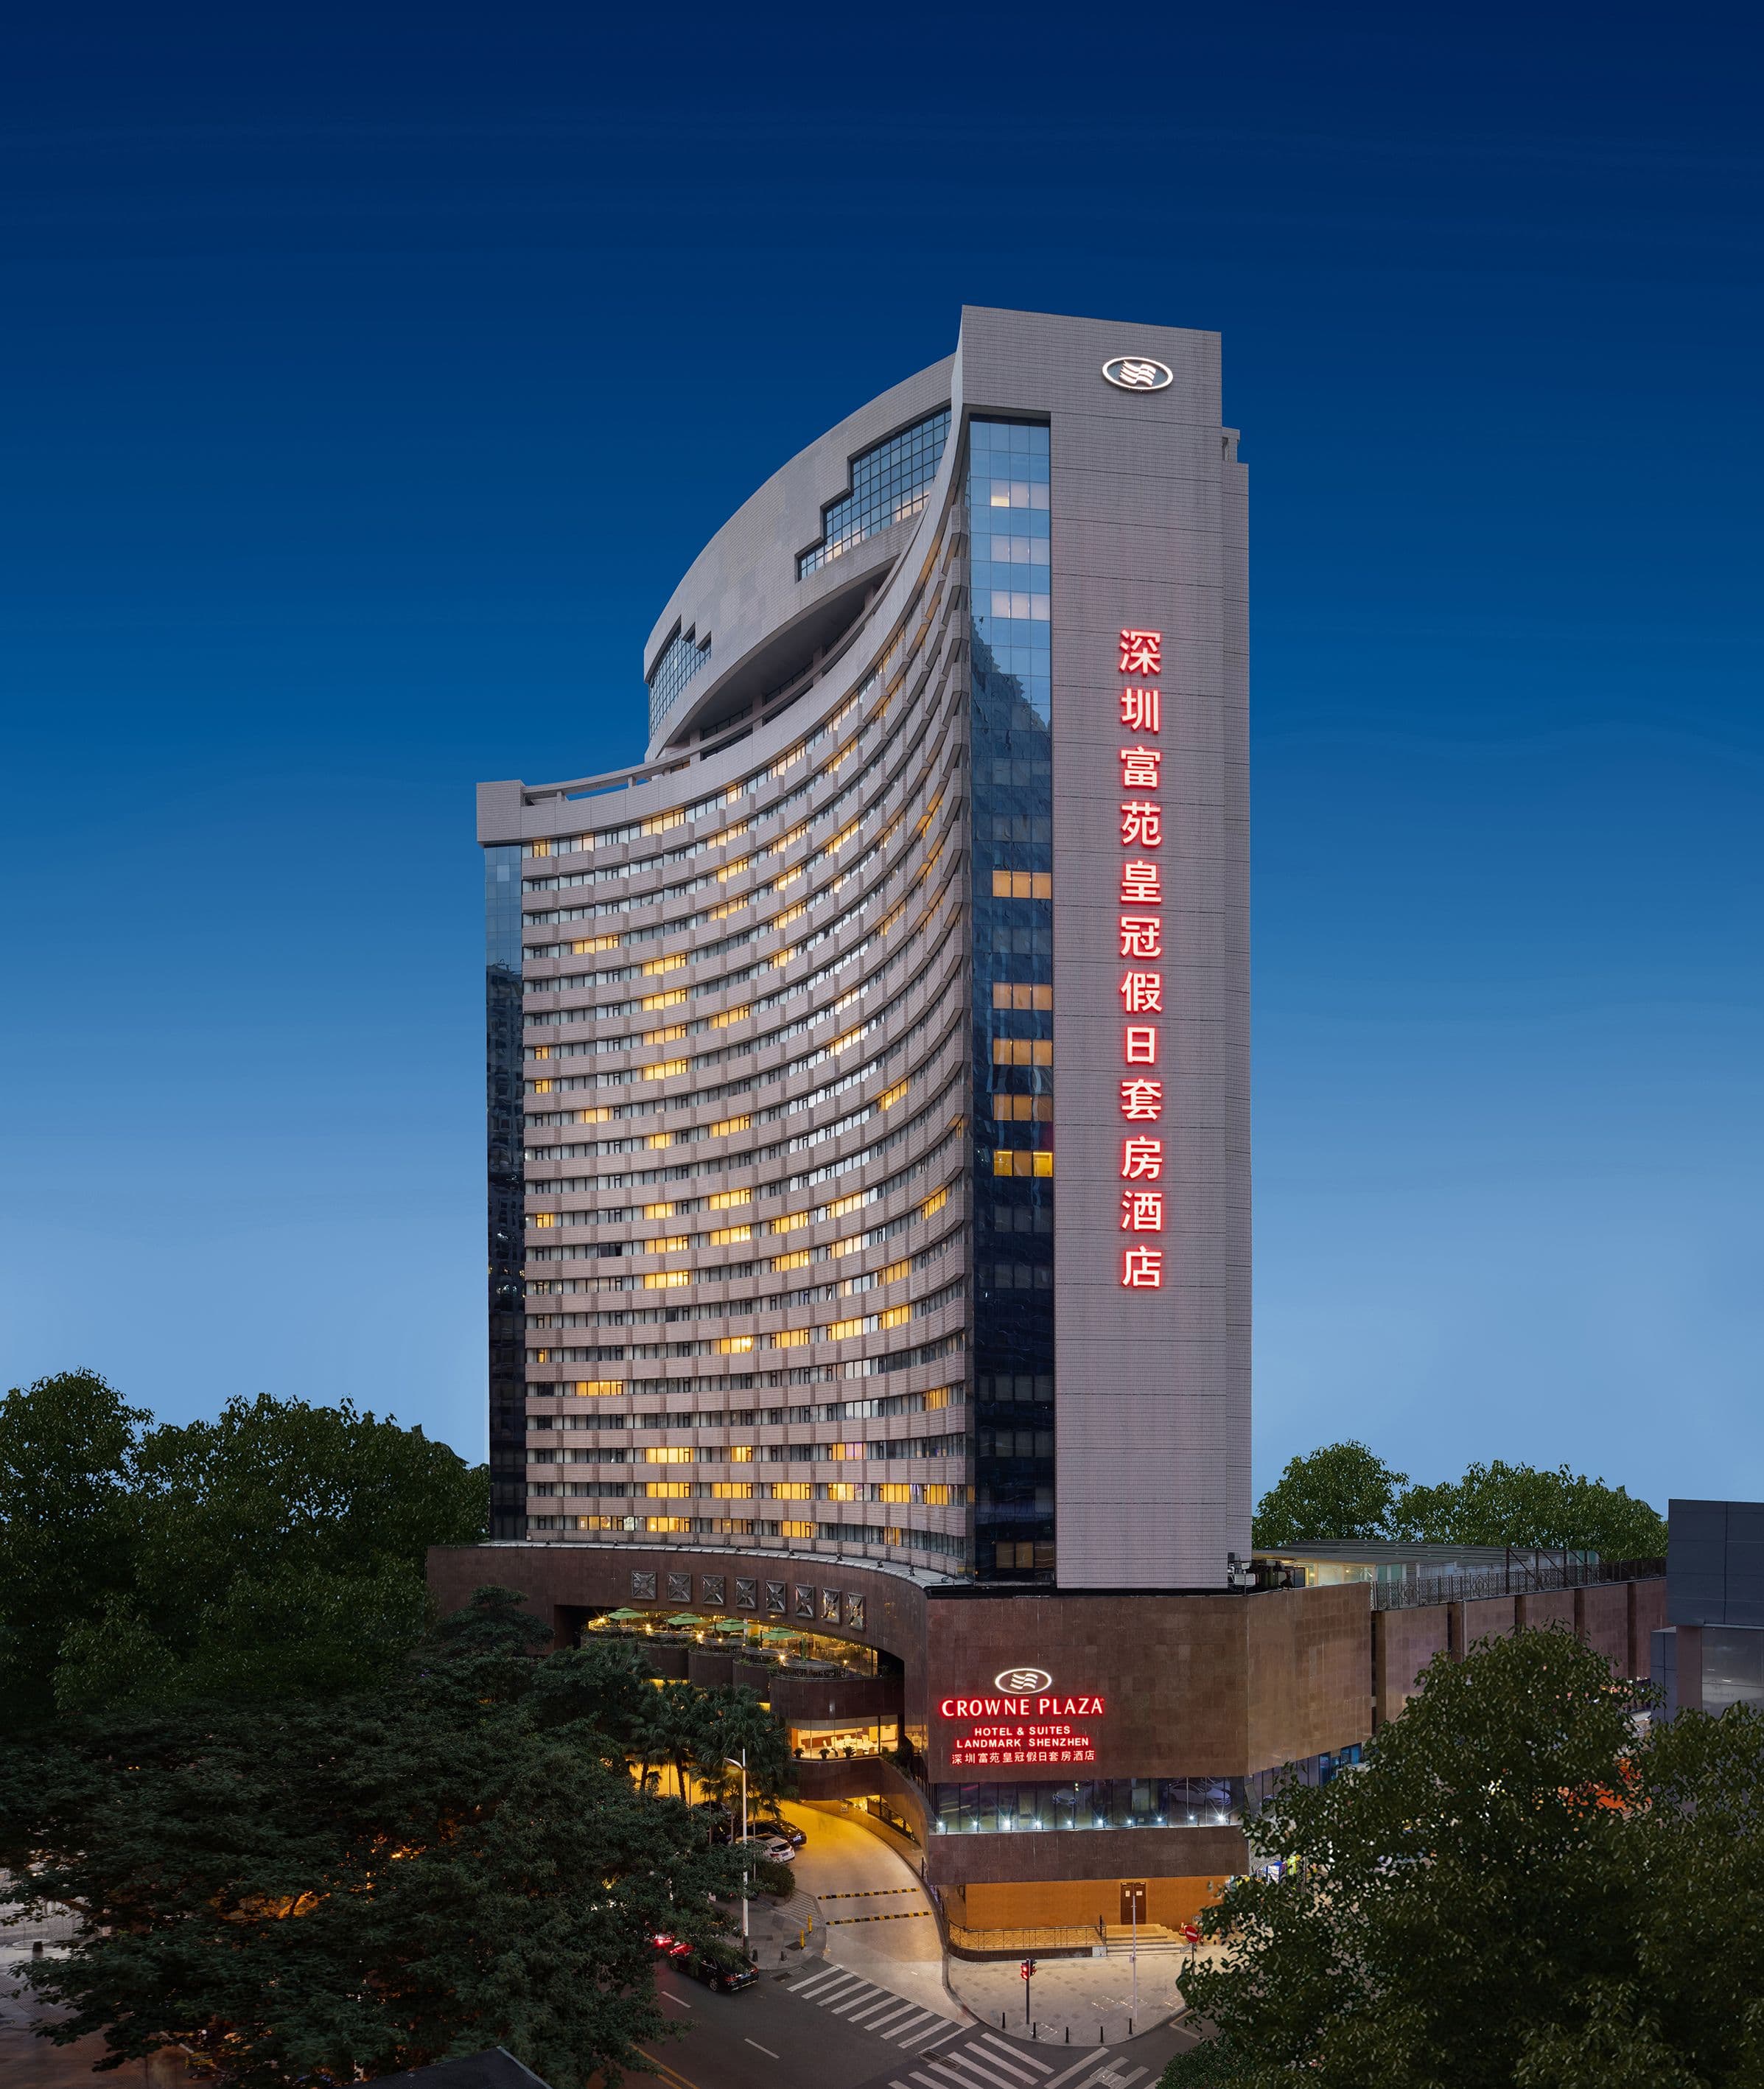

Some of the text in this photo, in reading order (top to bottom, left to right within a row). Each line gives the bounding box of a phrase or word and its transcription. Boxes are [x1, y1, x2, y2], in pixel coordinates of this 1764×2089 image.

[1119, 629, 1163, 1287] 深圳富苑皇冠假日套房酒店
[942, 1698, 1103, 1717] CROWNE PLAZA
[974, 1726, 1071, 1737] HOTEL & SUITES
[956, 1738, 1089, 1749] LANDMARK SHENZHEN
[951, 1750, 1095, 1765] 深圳富苑皇冠假日套房酒店
